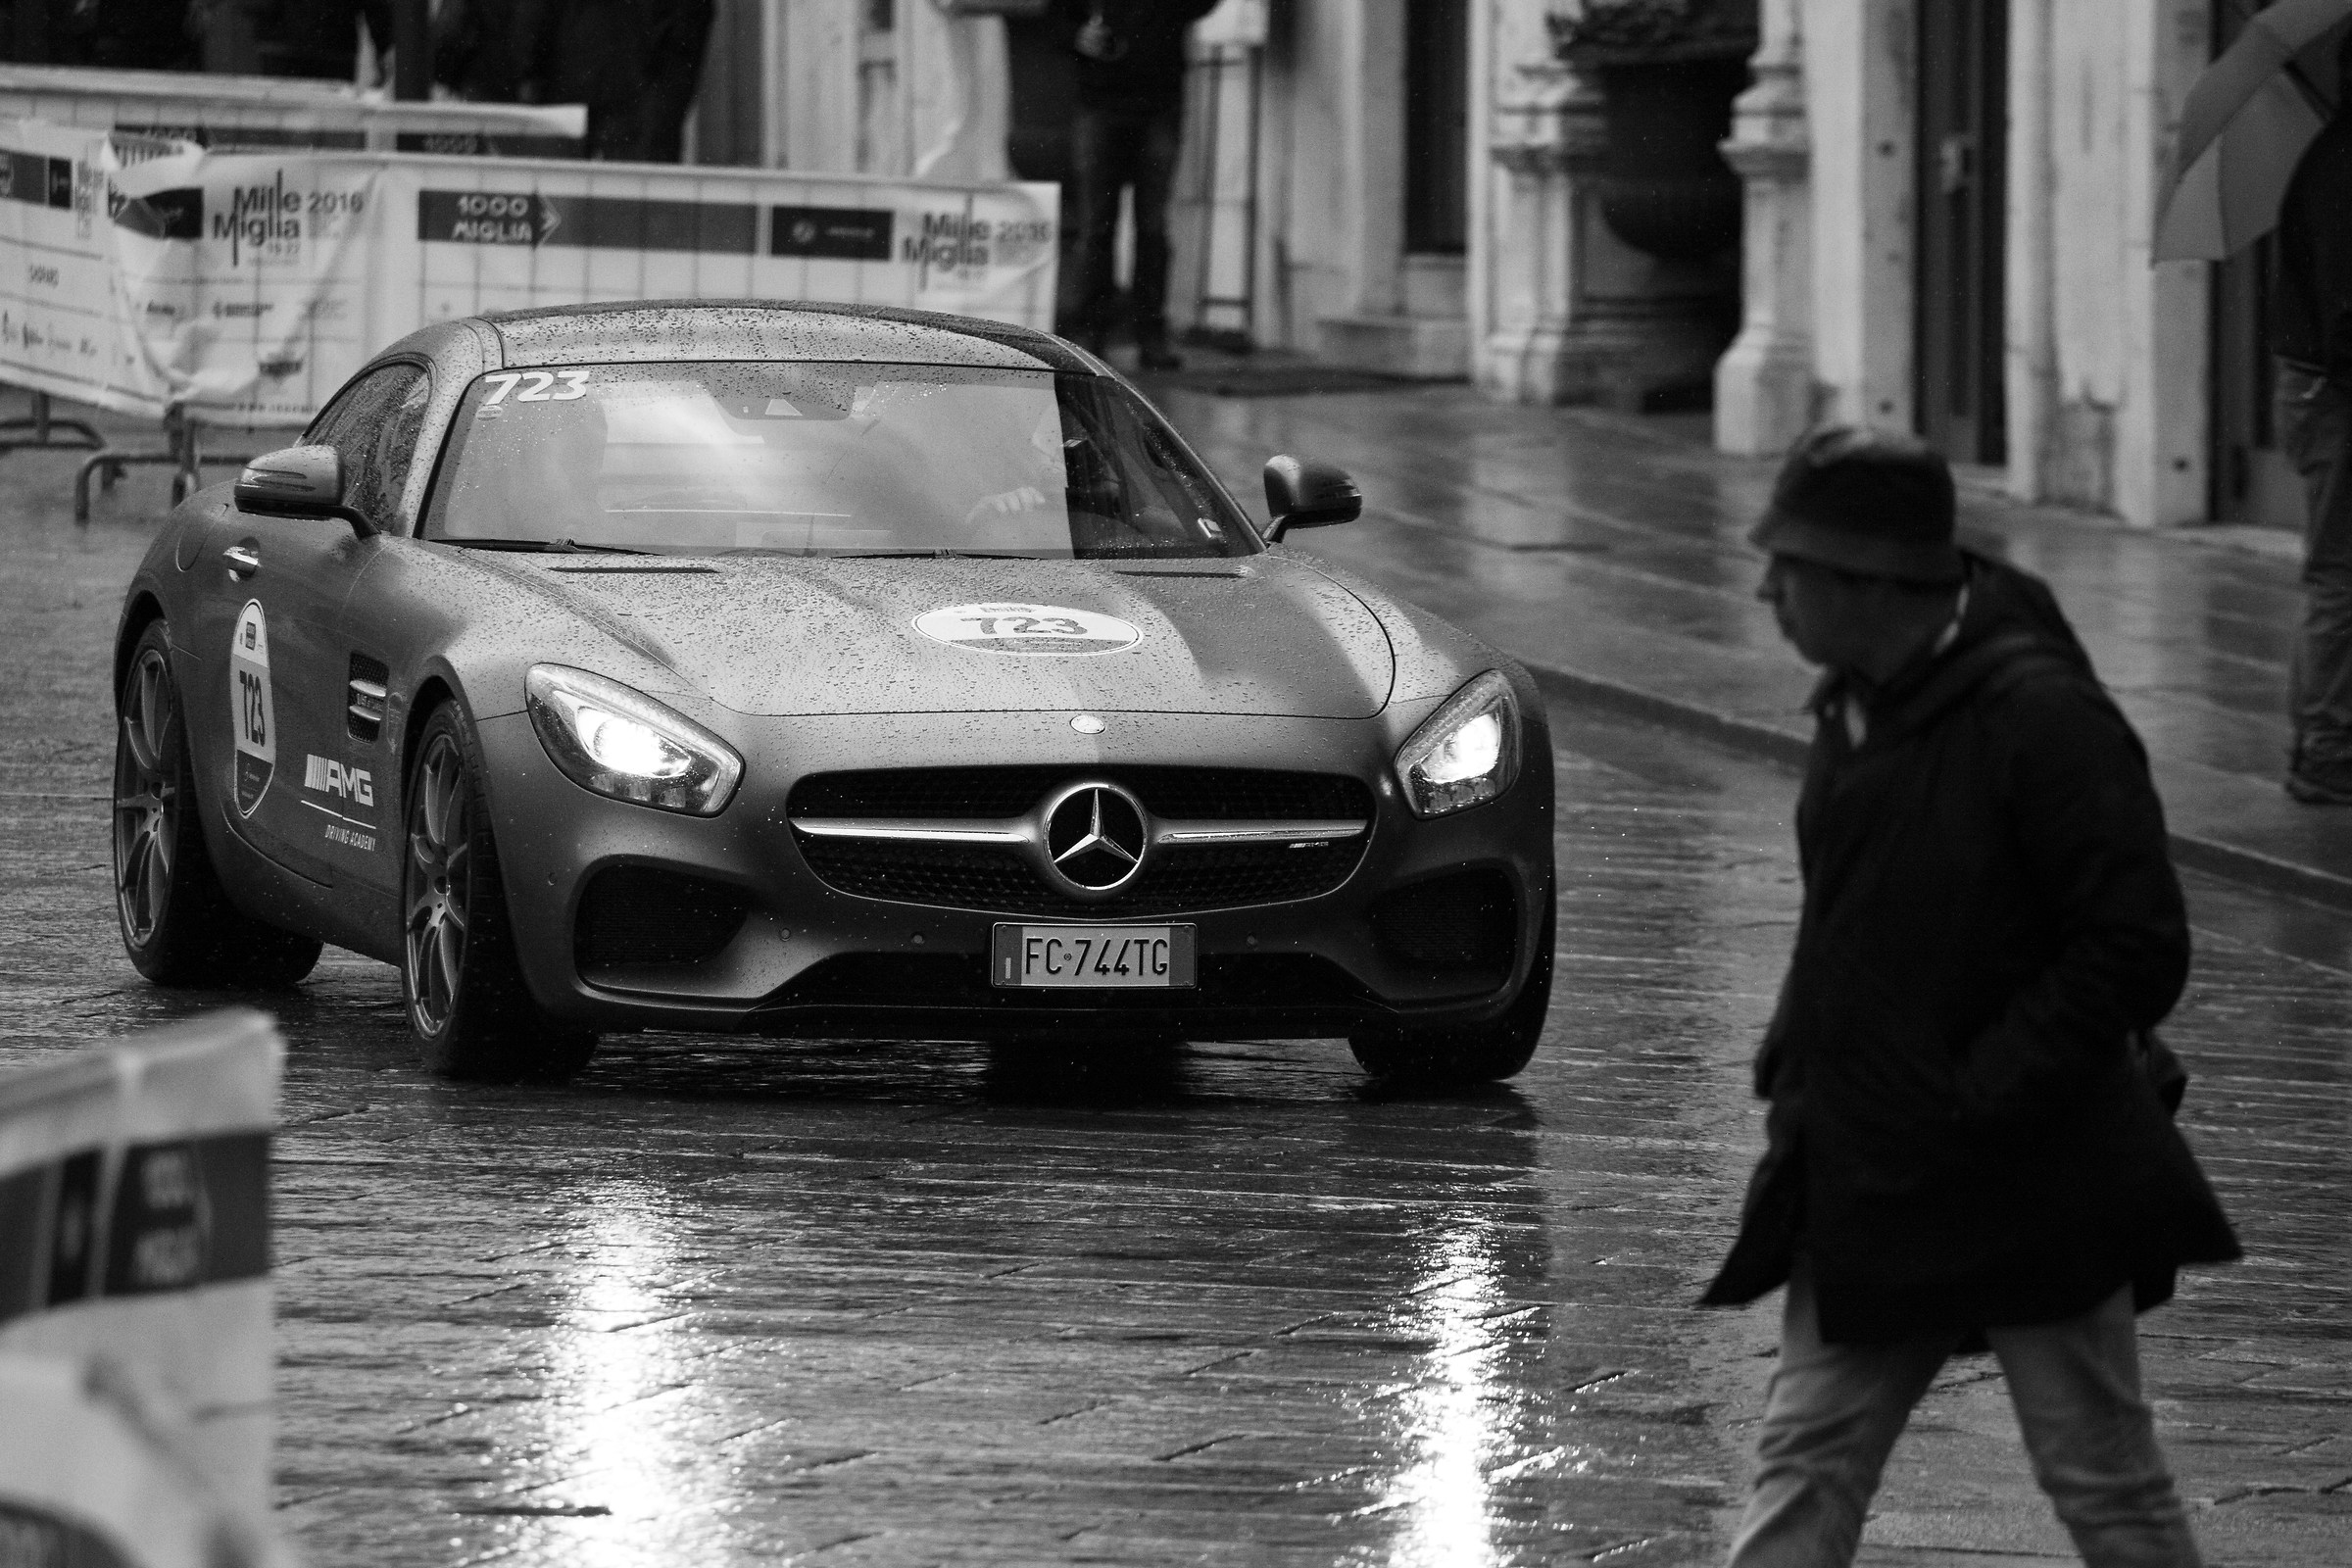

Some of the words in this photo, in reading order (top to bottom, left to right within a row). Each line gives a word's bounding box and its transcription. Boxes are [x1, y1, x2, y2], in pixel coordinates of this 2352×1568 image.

[233, 168, 301, 214] Mille
[309, 190, 364, 215] 2016
[458, 195, 529, 218] 1000
[213, 213, 300, 268] Miglia
[452, 219, 532, 244] MIGLIA
[485, 370, 590, 406] 723
[959, 615, 1089, 635] 723
[239, 669, 267, 748] 723
[324, 824, 350, 845] DRIVING
[349, 831, 376, 852] ACADEMY
[1025, 937, 1062, 975] FC
[1075, 938, 1168, 976] 744TG
